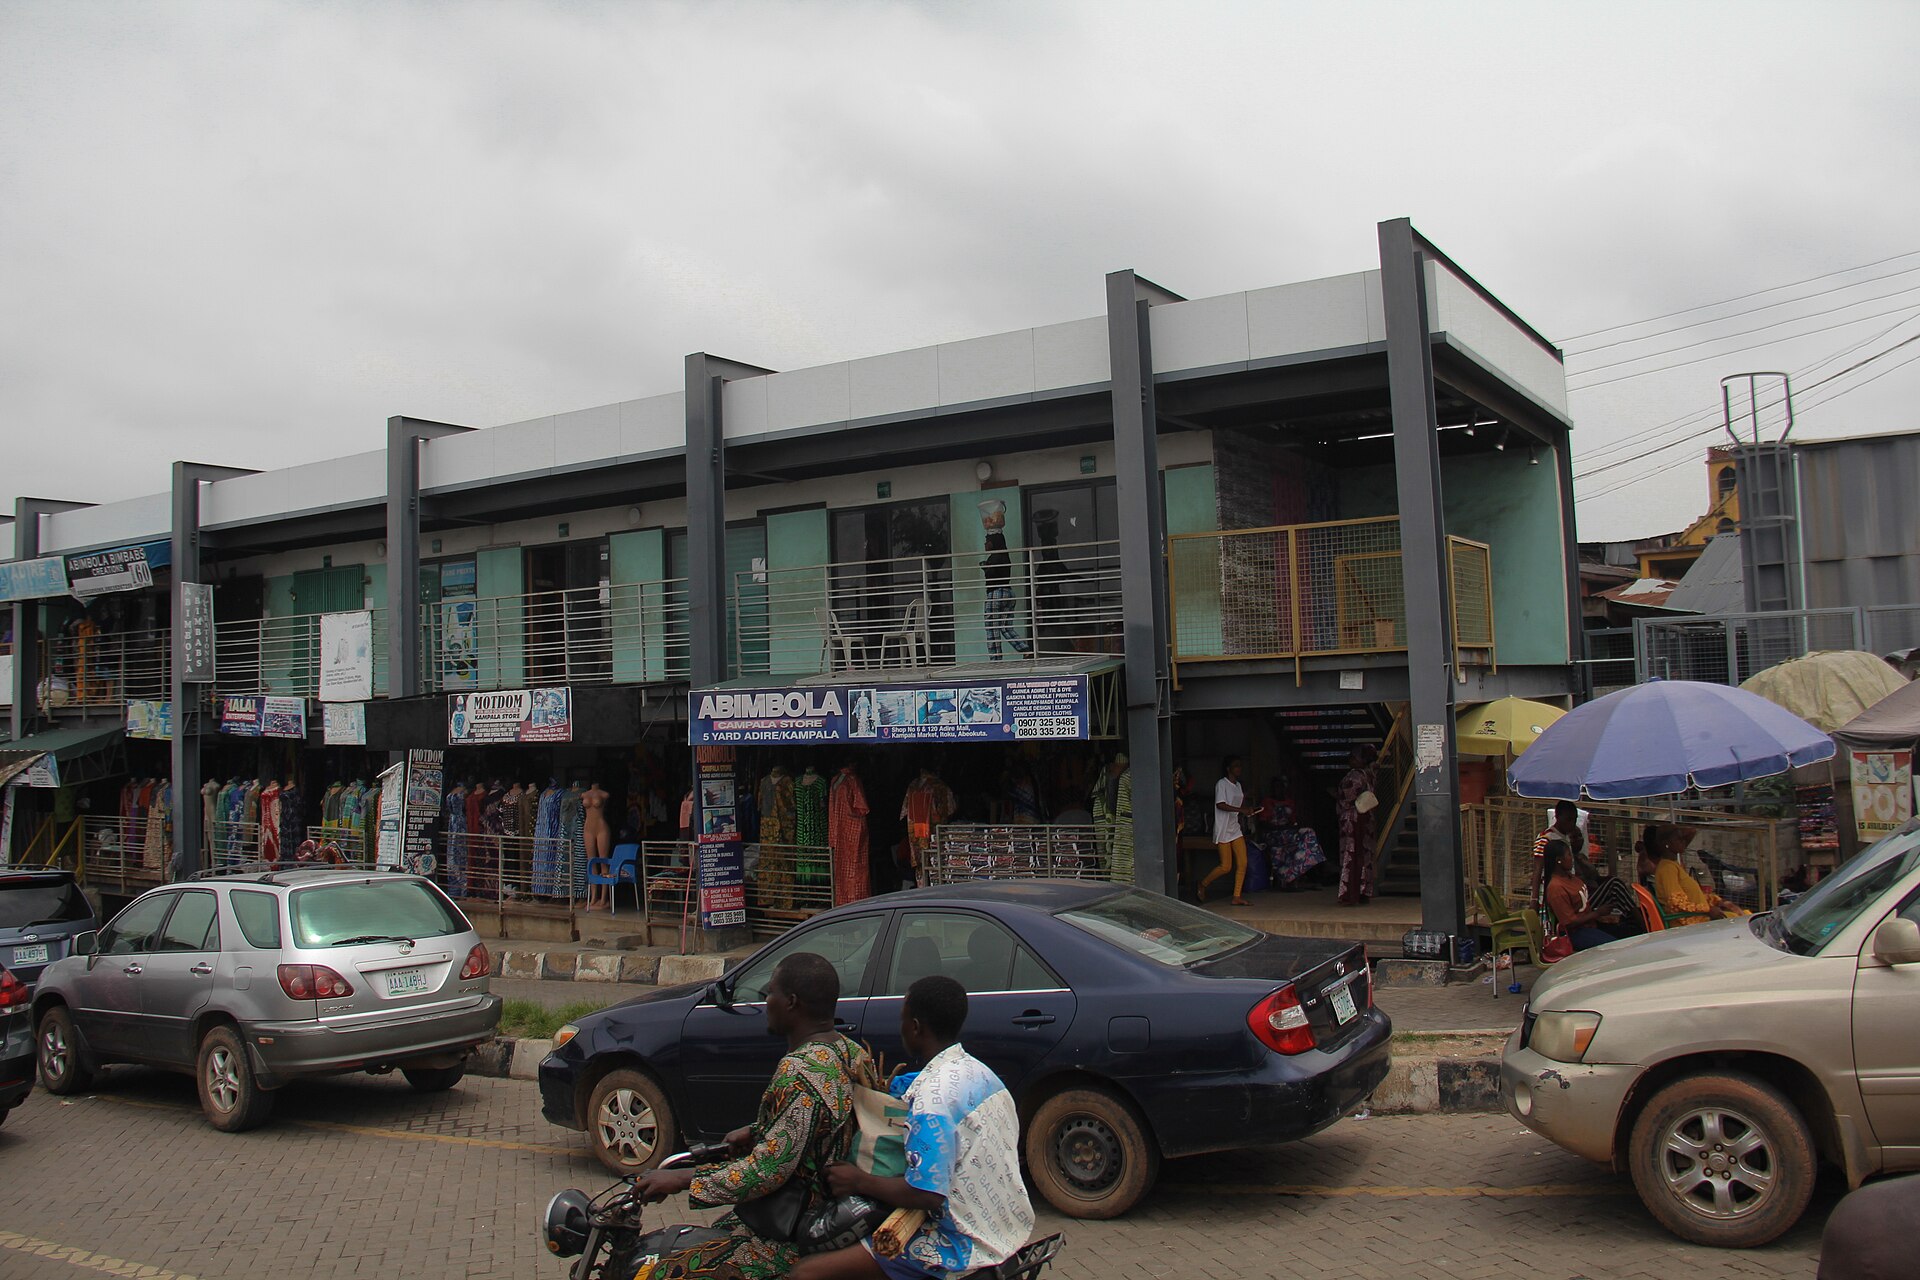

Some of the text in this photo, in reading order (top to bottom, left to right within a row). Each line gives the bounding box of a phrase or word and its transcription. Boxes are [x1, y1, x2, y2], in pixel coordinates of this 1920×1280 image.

[69, 548, 146, 571] ABIMBOLA BIMBABS
[92, 565, 124, 576] CREATIONS
[184, 587, 193, 673] ABIMBOLA
[195, 597, 203, 667] BIMBABS
[474, 695, 523, 710] MOTDOM
[698, 690, 844, 719] ABIMBOLA
[717, 720, 823, 730] CAMPALA STORE
[1018, 718, 1076, 727] 0907 325 9485
[712, 732, 741, 740] YARD
[744, 730, 840, 740] ADIRE/KAMPALA
[1018, 727, 1076, 737] 0803 335 2215
[412, 749, 444, 763] MOTDOM
[1855, 785, 1909, 822] POS
